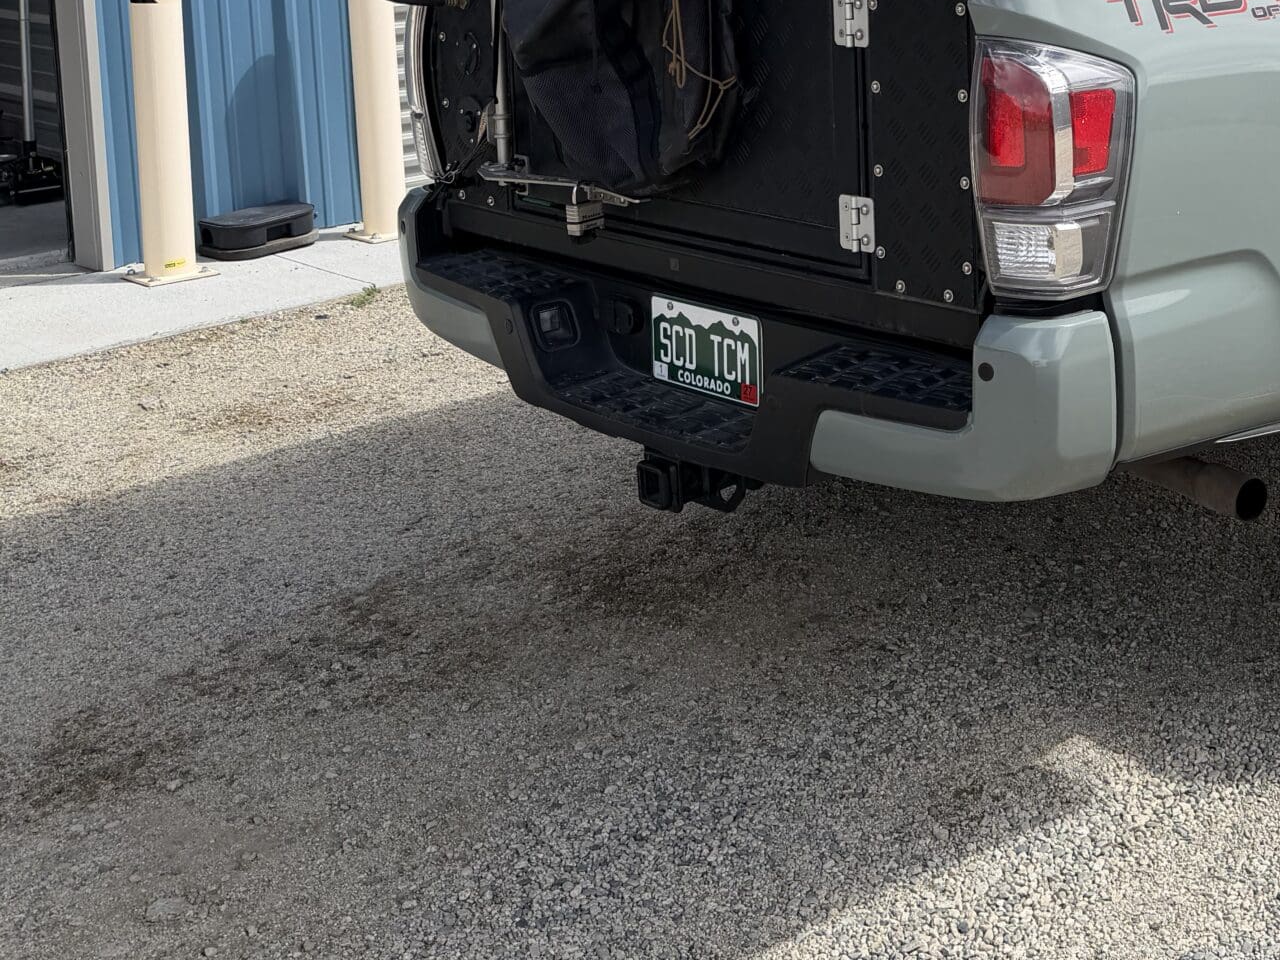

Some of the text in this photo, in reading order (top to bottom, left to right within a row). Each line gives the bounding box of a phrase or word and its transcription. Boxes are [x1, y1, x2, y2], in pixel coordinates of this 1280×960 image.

[660, 321, 750, 386] SCD TCM
[677, 369, 731, 395] COLORADO
